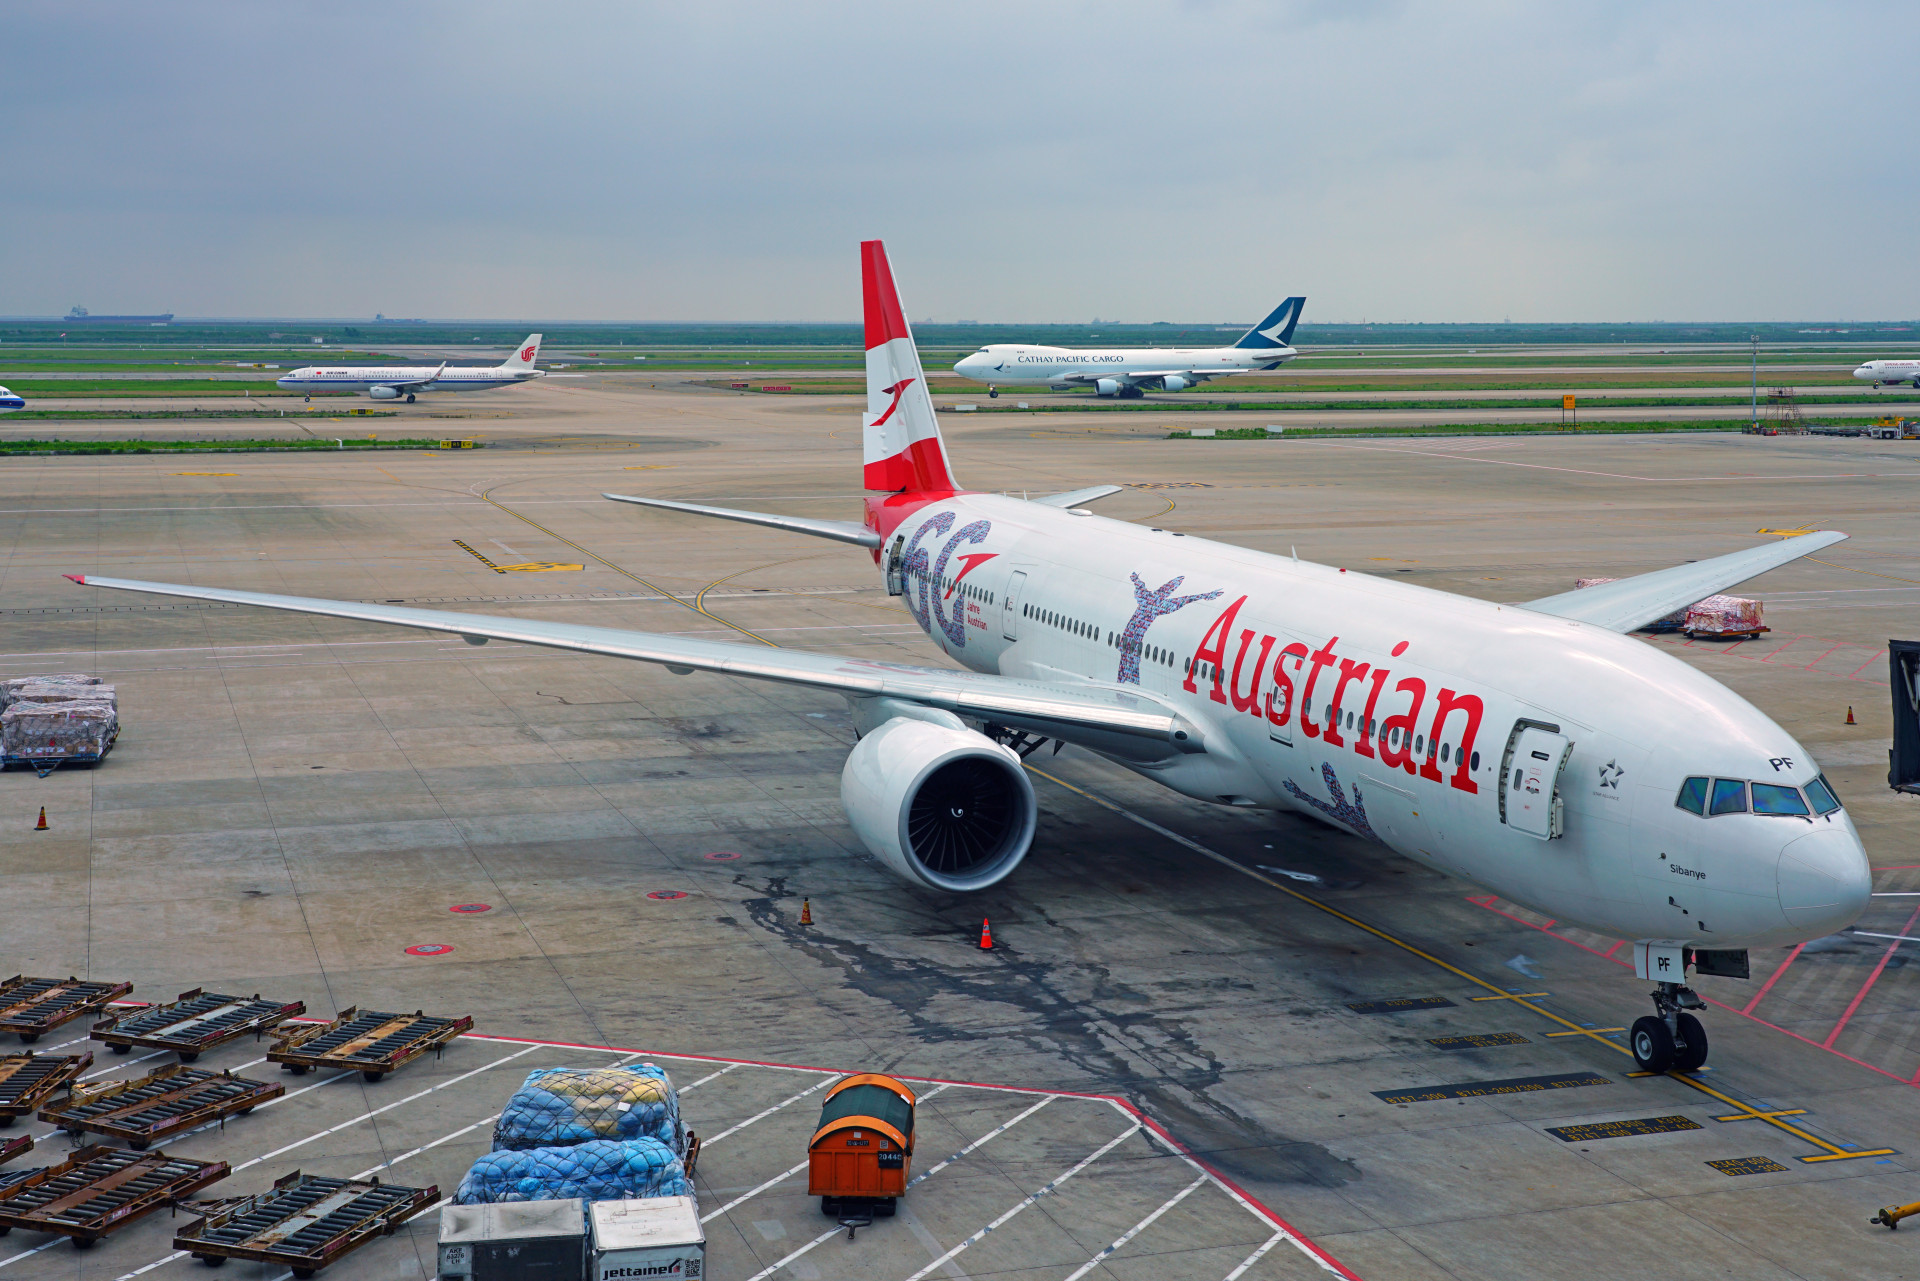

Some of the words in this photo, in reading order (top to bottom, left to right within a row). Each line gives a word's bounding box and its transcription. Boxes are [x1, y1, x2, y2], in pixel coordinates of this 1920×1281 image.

[1018, 355, 1054, 363] CATHAY
[1056, 355, 1090, 363] PACIFIC
[1092, 355, 1124, 363] CARGO
[967, 600, 980, 615] Jahre
[967, 614, 988, 631] Austrian
[1183, 594, 1485, 795] Austrian
[1769, 757, 1794, 772] PF
[1670, 864, 1706, 881] Sibanye
[1658, 957, 1670, 971] PF
[1385, 1092, 1447, 1104] B757-300
[1456, 1083, 1545, 1098] B767-200/300
[1551, 1077, 1611, 1089] B777-200
[1557, 1120, 1646, 1135] A340-300/500
[1567, 1129, 1632, 1142] B747-400
[1638, 1122, 1701, 1134] B767-400
[1709, 1157, 1772, 1168] A340-600
[1721, 1164, 1787, 1176] B777-300
[602, 1258, 682, 1281] jettainer
